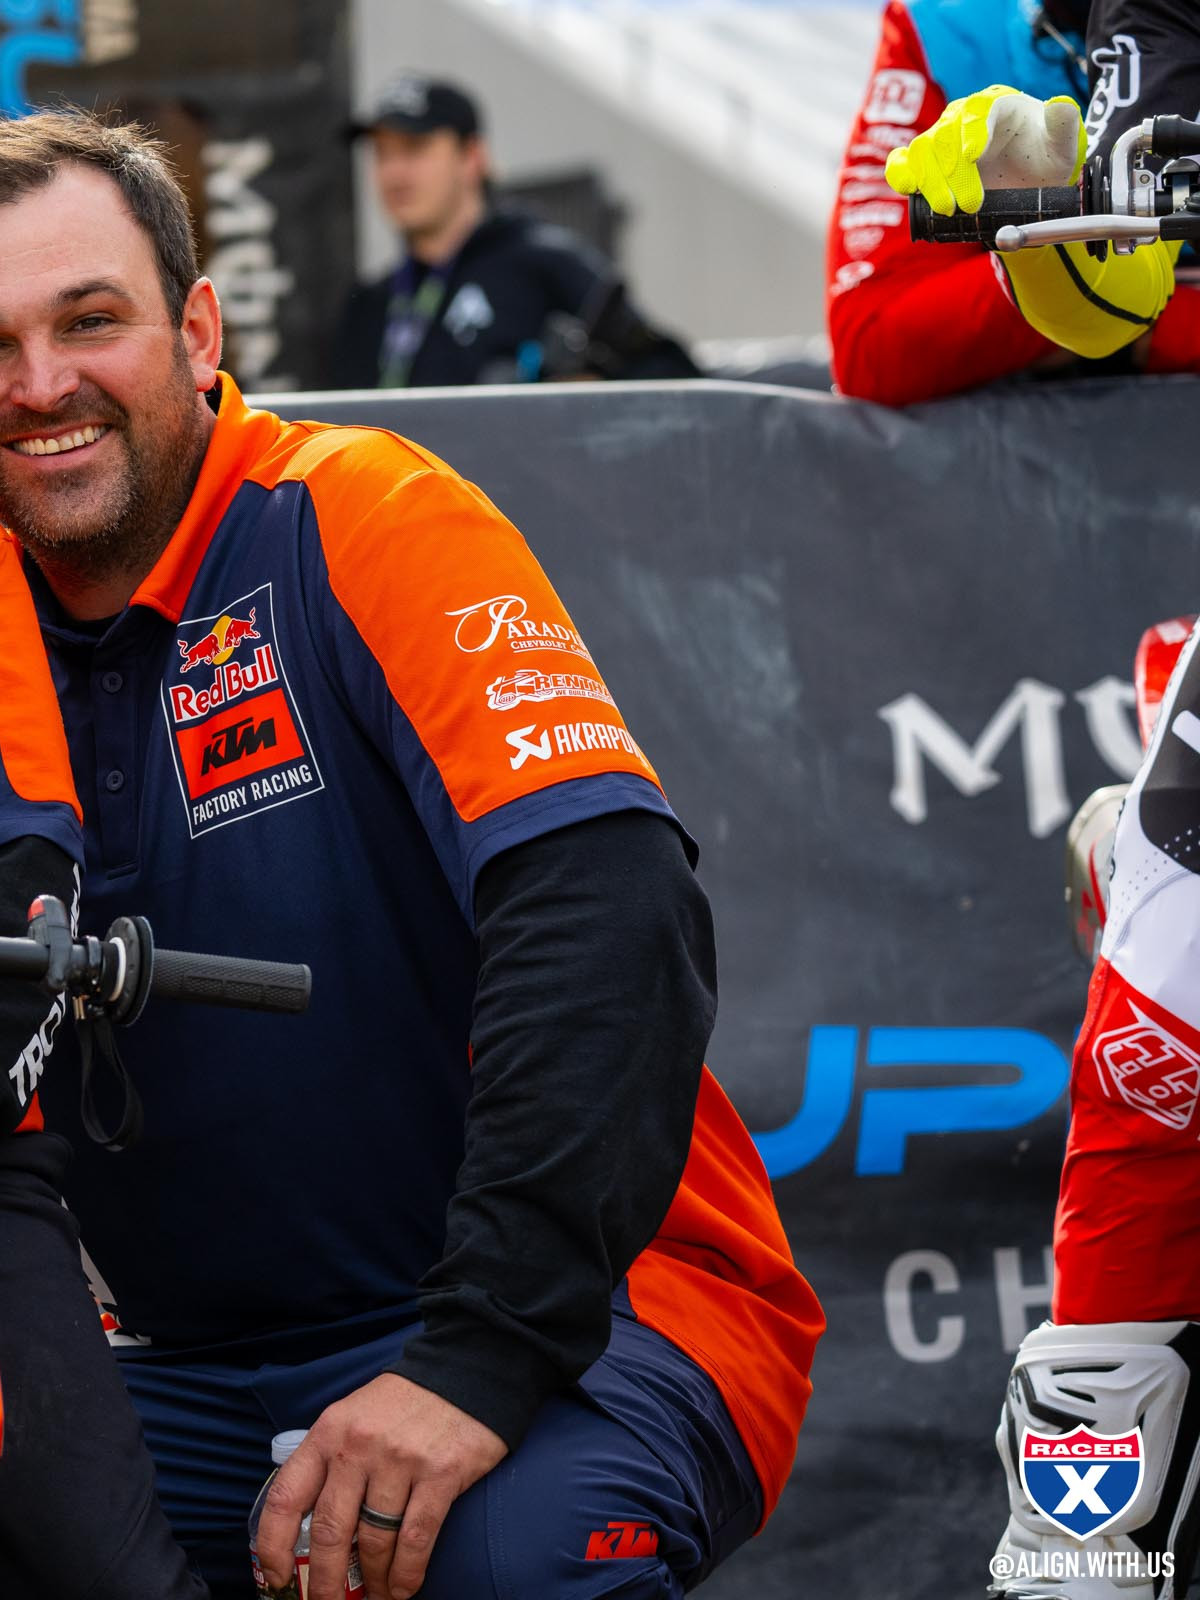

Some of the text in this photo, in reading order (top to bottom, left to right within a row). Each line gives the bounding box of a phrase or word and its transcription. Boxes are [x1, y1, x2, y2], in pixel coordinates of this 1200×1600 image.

[510, 639, 567, 651] CHEVROLET
[169, 643, 279, 723] Red Bull
[201, 716, 278, 777] KTM
[192, 763, 314, 826] FACTORY RACING
[584, 1521, 660, 1562] KTM
